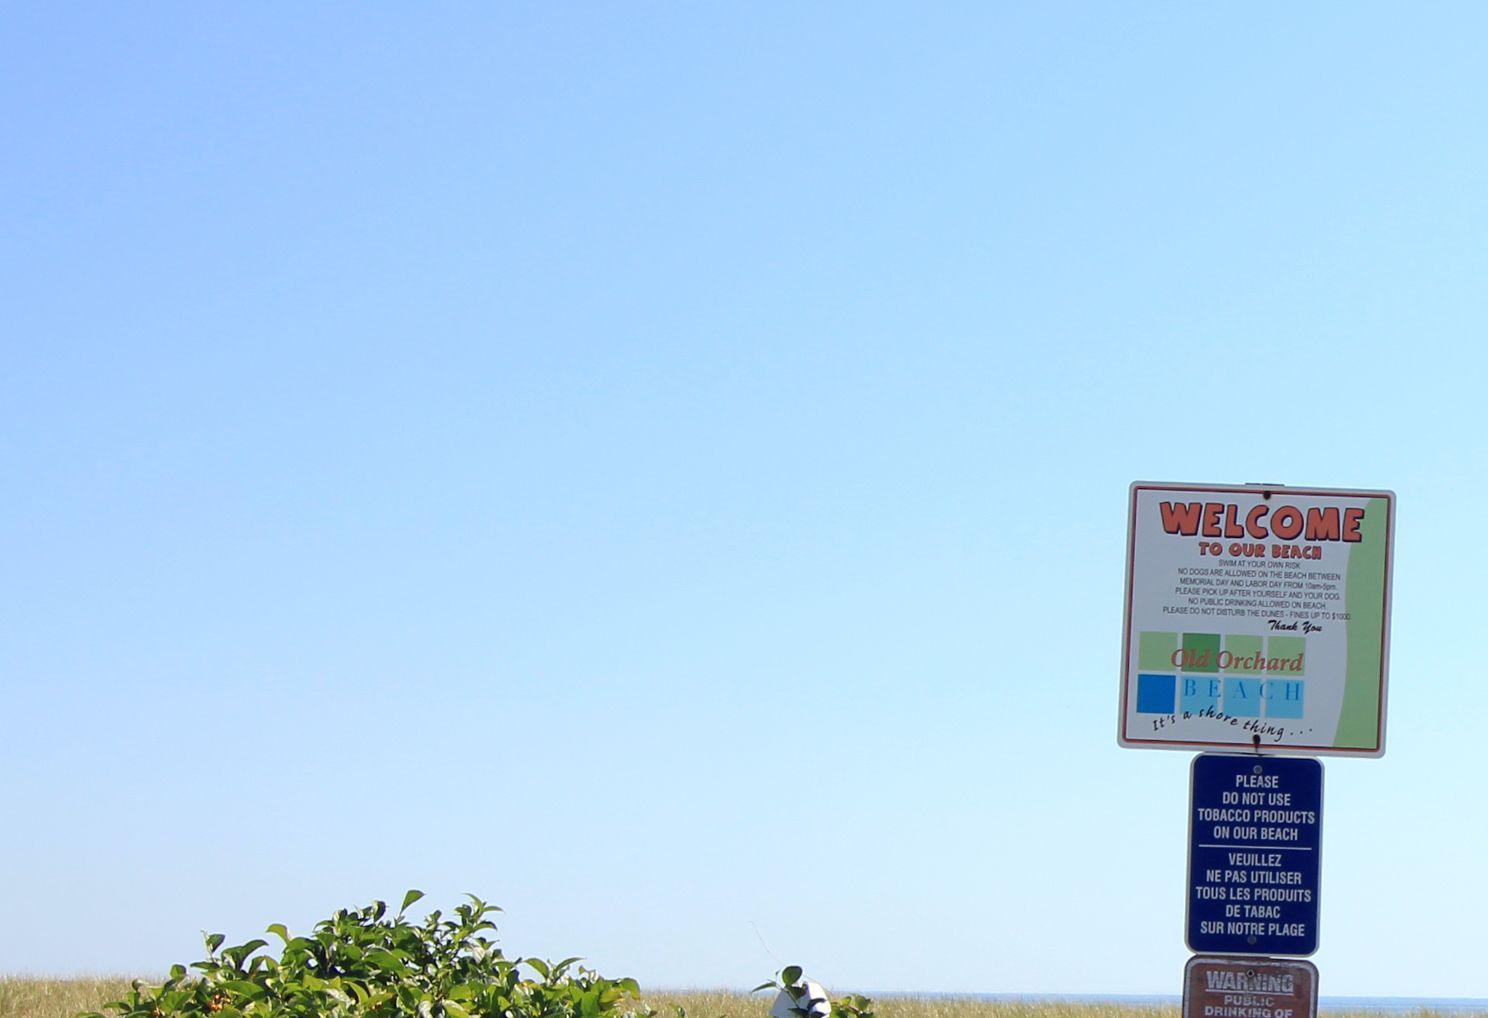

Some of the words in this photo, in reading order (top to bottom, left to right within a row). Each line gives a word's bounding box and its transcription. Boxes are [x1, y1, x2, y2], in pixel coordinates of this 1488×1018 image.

[1160, 501, 1364, 542] WELCOME
[1199, 542, 1223, 556] TO
[1229, 543, 1265, 557] OUR
[1272, 545, 1322, 560] BEACH
[1190, 568, 1208, 576] DOGS
[1224, 570, 1256, 578] ALLOWED
[1270, 571, 1282, 579] THE
[1284, 572, 1306, 580] BEACH
[1308, 573, 1341, 581] BETWEEN
[1180, 578, 1214, 586] MEMORIAL
[1284, 581, 1303, 589] FROM
[1175, 587, 1201, 595] PLEASE
[1230, 589, 1251, 597] AFTER
[1252, 590, 1287, 598] YOURSELF
[1288, 591, 1303, 599] AND
[1200, 598, 1223, 606] PUBLIC
[1225, 599, 1256, 607] DRINKING
[1258, 600, 1290, 609] ALLOWED
[1162, 606, 1188, 614] PLEASE
[1201, 607, 1215, 615] NOT
[1216, 608, 1246, 616] DISTURB
[1247, 609, 1259, 617] THE
[1261, 610, 1284, 618] DUNES
[1290, 610, 1309, 619] FINES
[1311, 611, 1320, 619] UP
[1321, 612, 1331, 620] TO
[1268, 619, 1298, 631] Thank
[1302, 620, 1322, 635] You
[1171, 648, 1212, 668] Old
[1216, 650, 1304, 672] Orchard
[1184, 679, 1300, 701] BEACH
[1153, 715, 1175, 731] It's
[1183, 711, 1192, 719] a
[1199, 705, 1239, 725] shore
[1236, 775, 1279, 788] PLEASE
[1223, 792, 1238, 804] DO
[1242, 793, 1265, 805] NOT
[1269, 794, 1291, 806] USE
[1198, 809, 1250, 822] TOBACCO
[1254, 811, 1315, 824] PRODUCTS
[1214, 826, 1229, 838] ON
[1233, 827, 1257, 839] OUR
[1261, 828, 1298, 840] BEACH
[1229, 853, 1282, 867] VEUILLEZ
[1206, 869, 1221, 881] NE
[1225, 871, 1247, 883] PAS
[1251, 872, 1302, 884] UTILISER
[1196, 887, 1226, 899] TOUS
[1230, 888, 1250, 901] LES
[1254, 889, 1311, 902] PRODUITS
[1226, 905, 1241, 917] DE
[1244, 906, 1281, 919] TABAC
[1200, 921, 1224, 934] SUR
[1227, 923, 1265, 935] NOTRE
[1269, 924, 1305, 937] PLAGE
[1206, 970, 1294, 993] WARNING
[1224, 995, 1275, 1007] PUBLIC
[1204, 1006, 1271, 1018] DRINKING
[1274, 1009, 1293, 1018] OF
